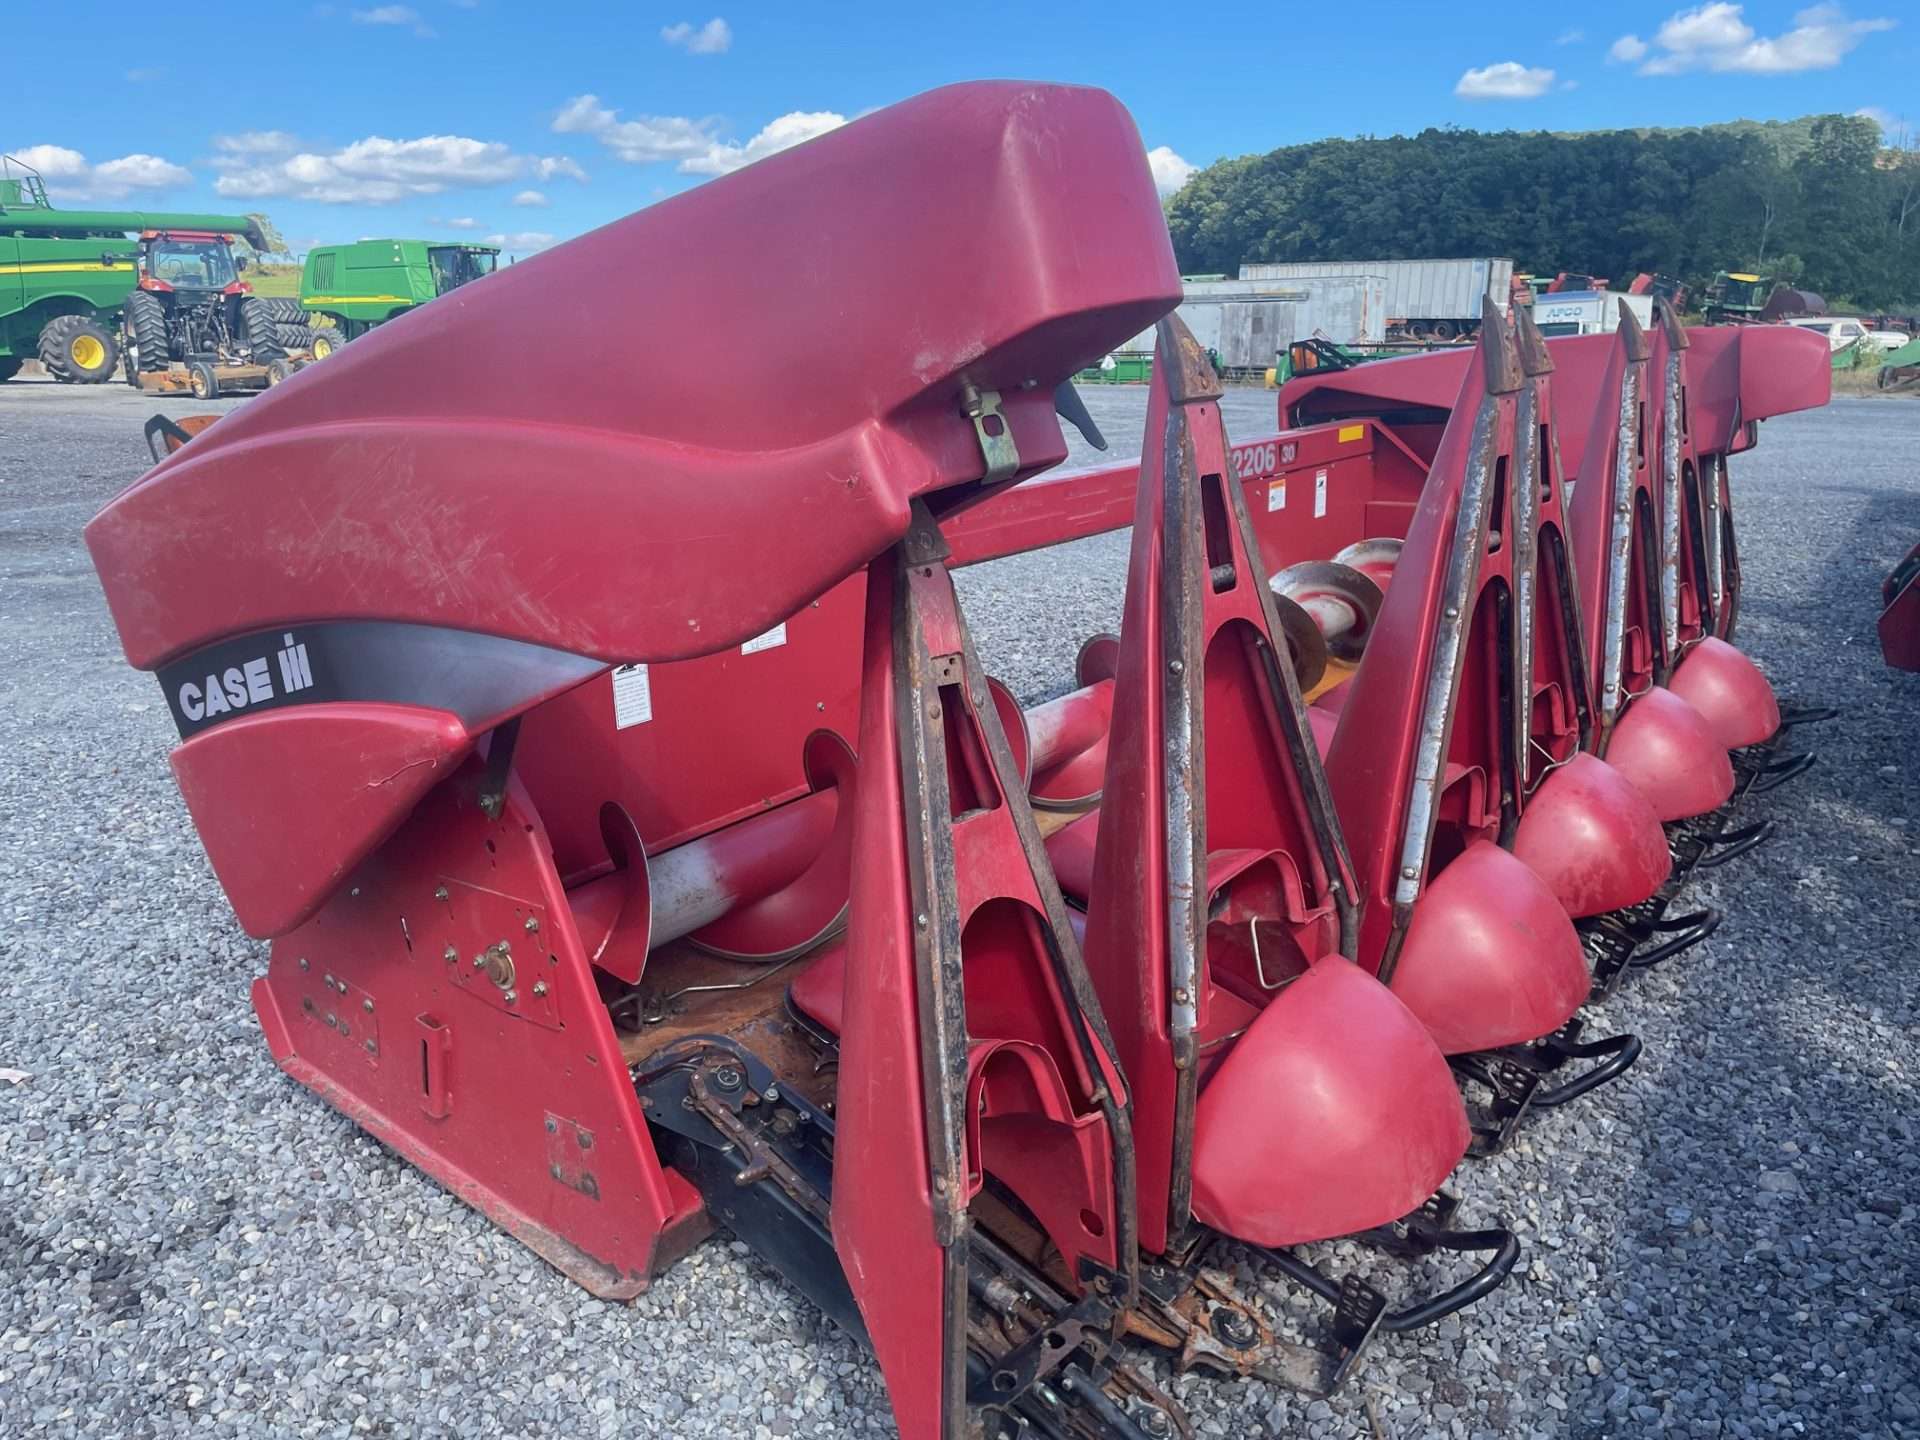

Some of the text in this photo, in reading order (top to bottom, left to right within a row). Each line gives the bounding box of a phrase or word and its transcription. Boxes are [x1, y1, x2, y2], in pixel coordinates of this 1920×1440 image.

[1233, 444, 1294, 477] 2206 30
[179, 657, 274, 721] CASE
